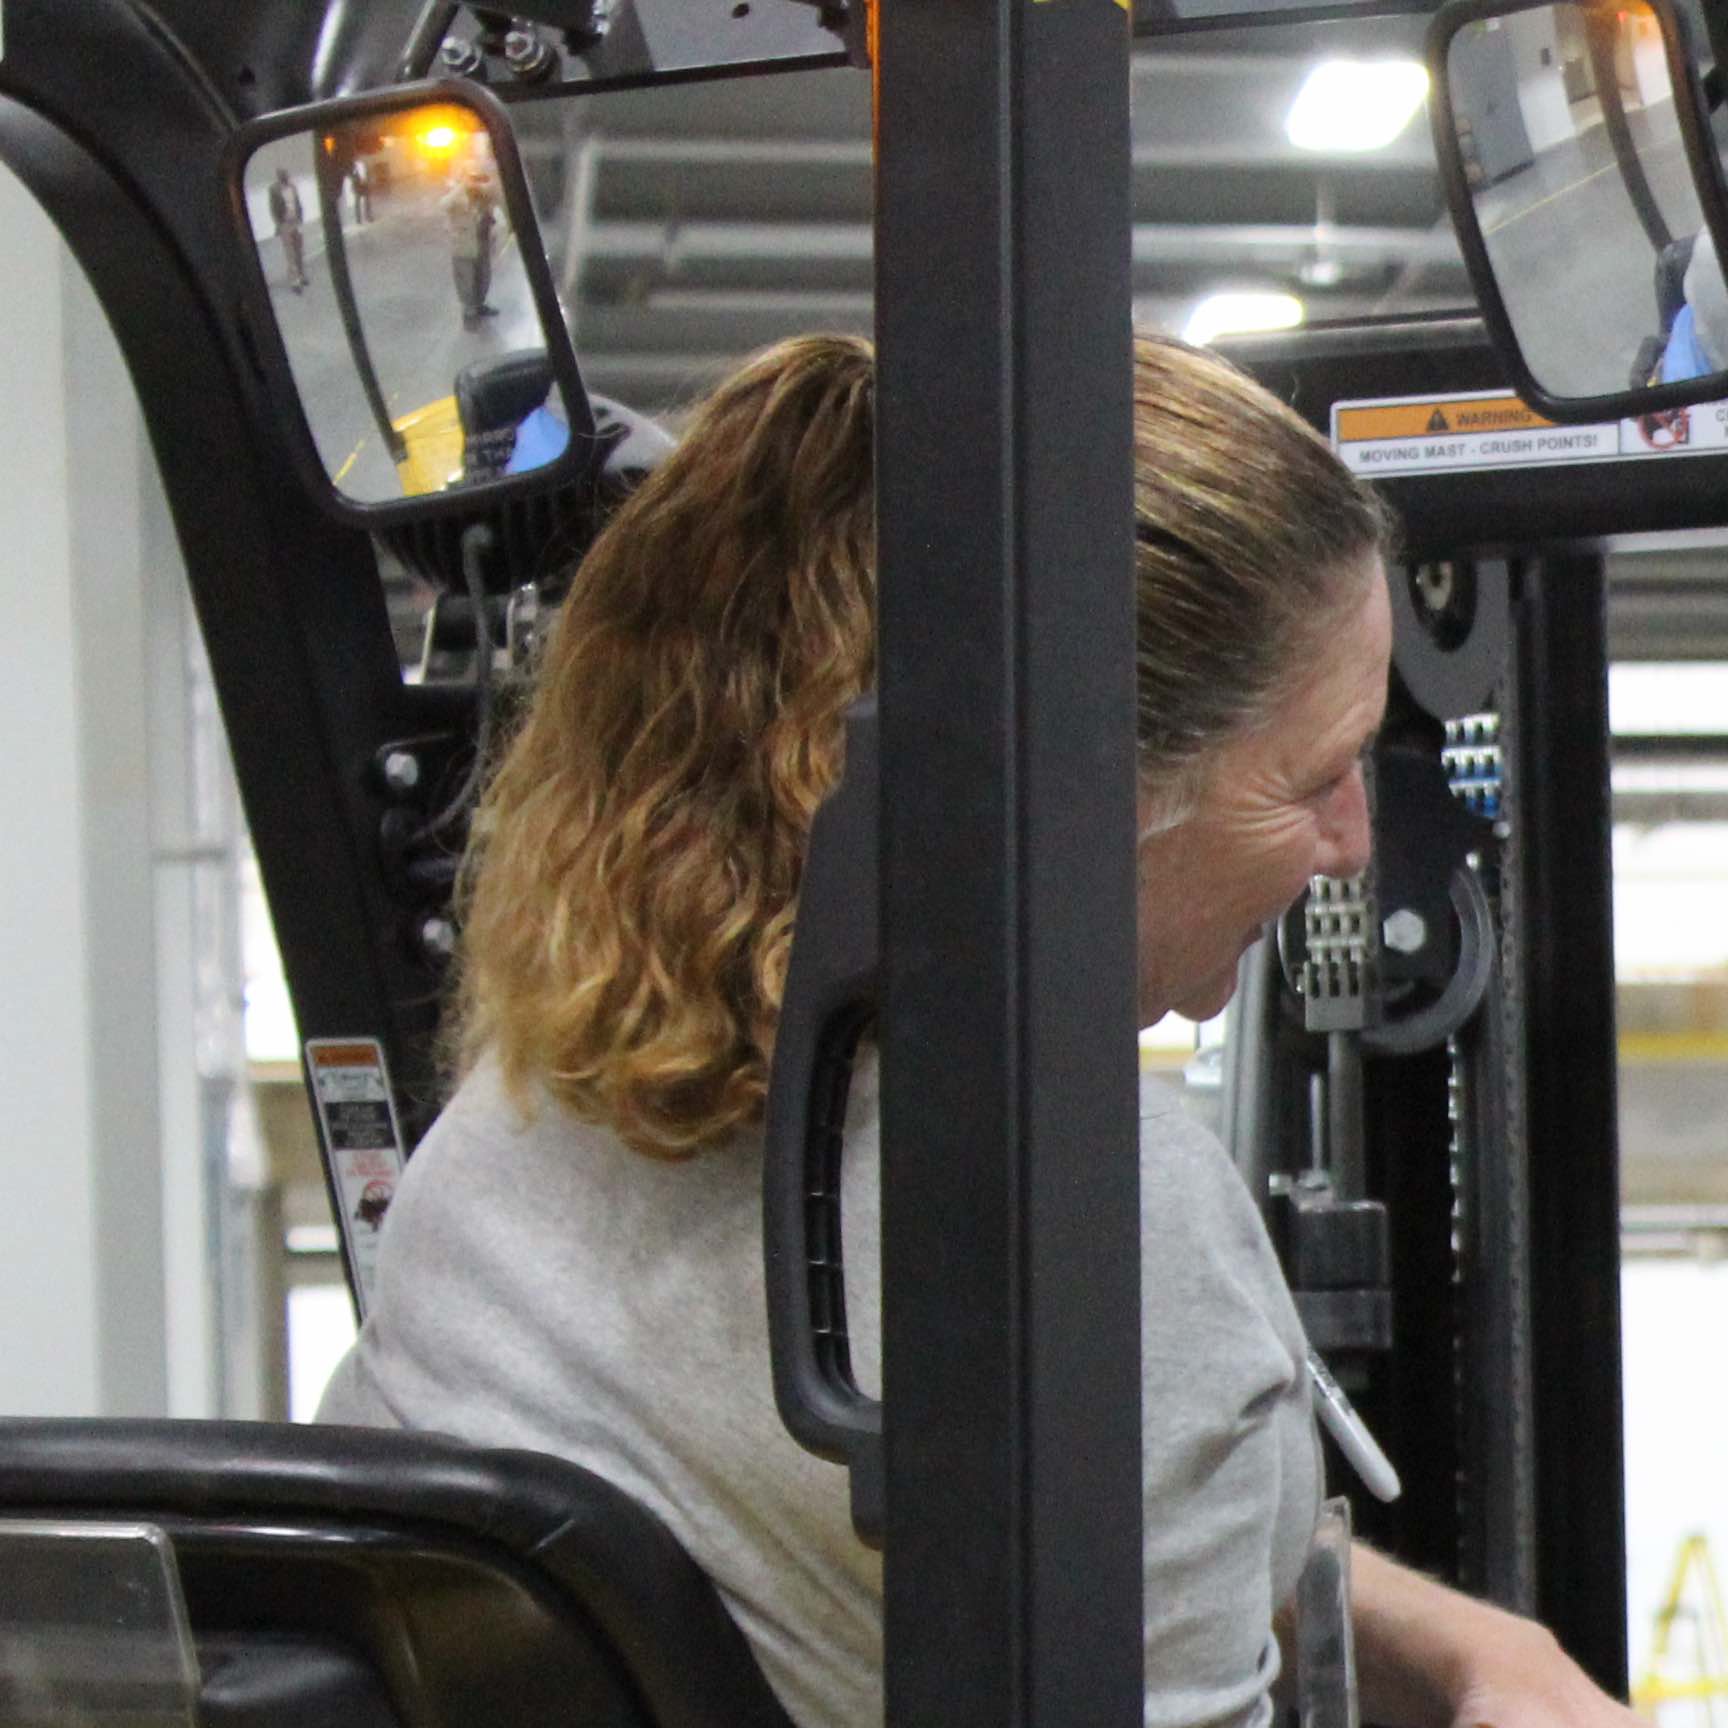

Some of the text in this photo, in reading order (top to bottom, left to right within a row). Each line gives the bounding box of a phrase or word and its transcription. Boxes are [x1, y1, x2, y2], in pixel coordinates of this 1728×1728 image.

[1457, 409, 1532, 426] WARNING
[1359, 446, 1419, 463] MOVING
[1424, 443, 1466, 459] MAST
[1479, 439, 1533, 456] CRUSH
[1537, 433, 1598, 450] POINTS!
